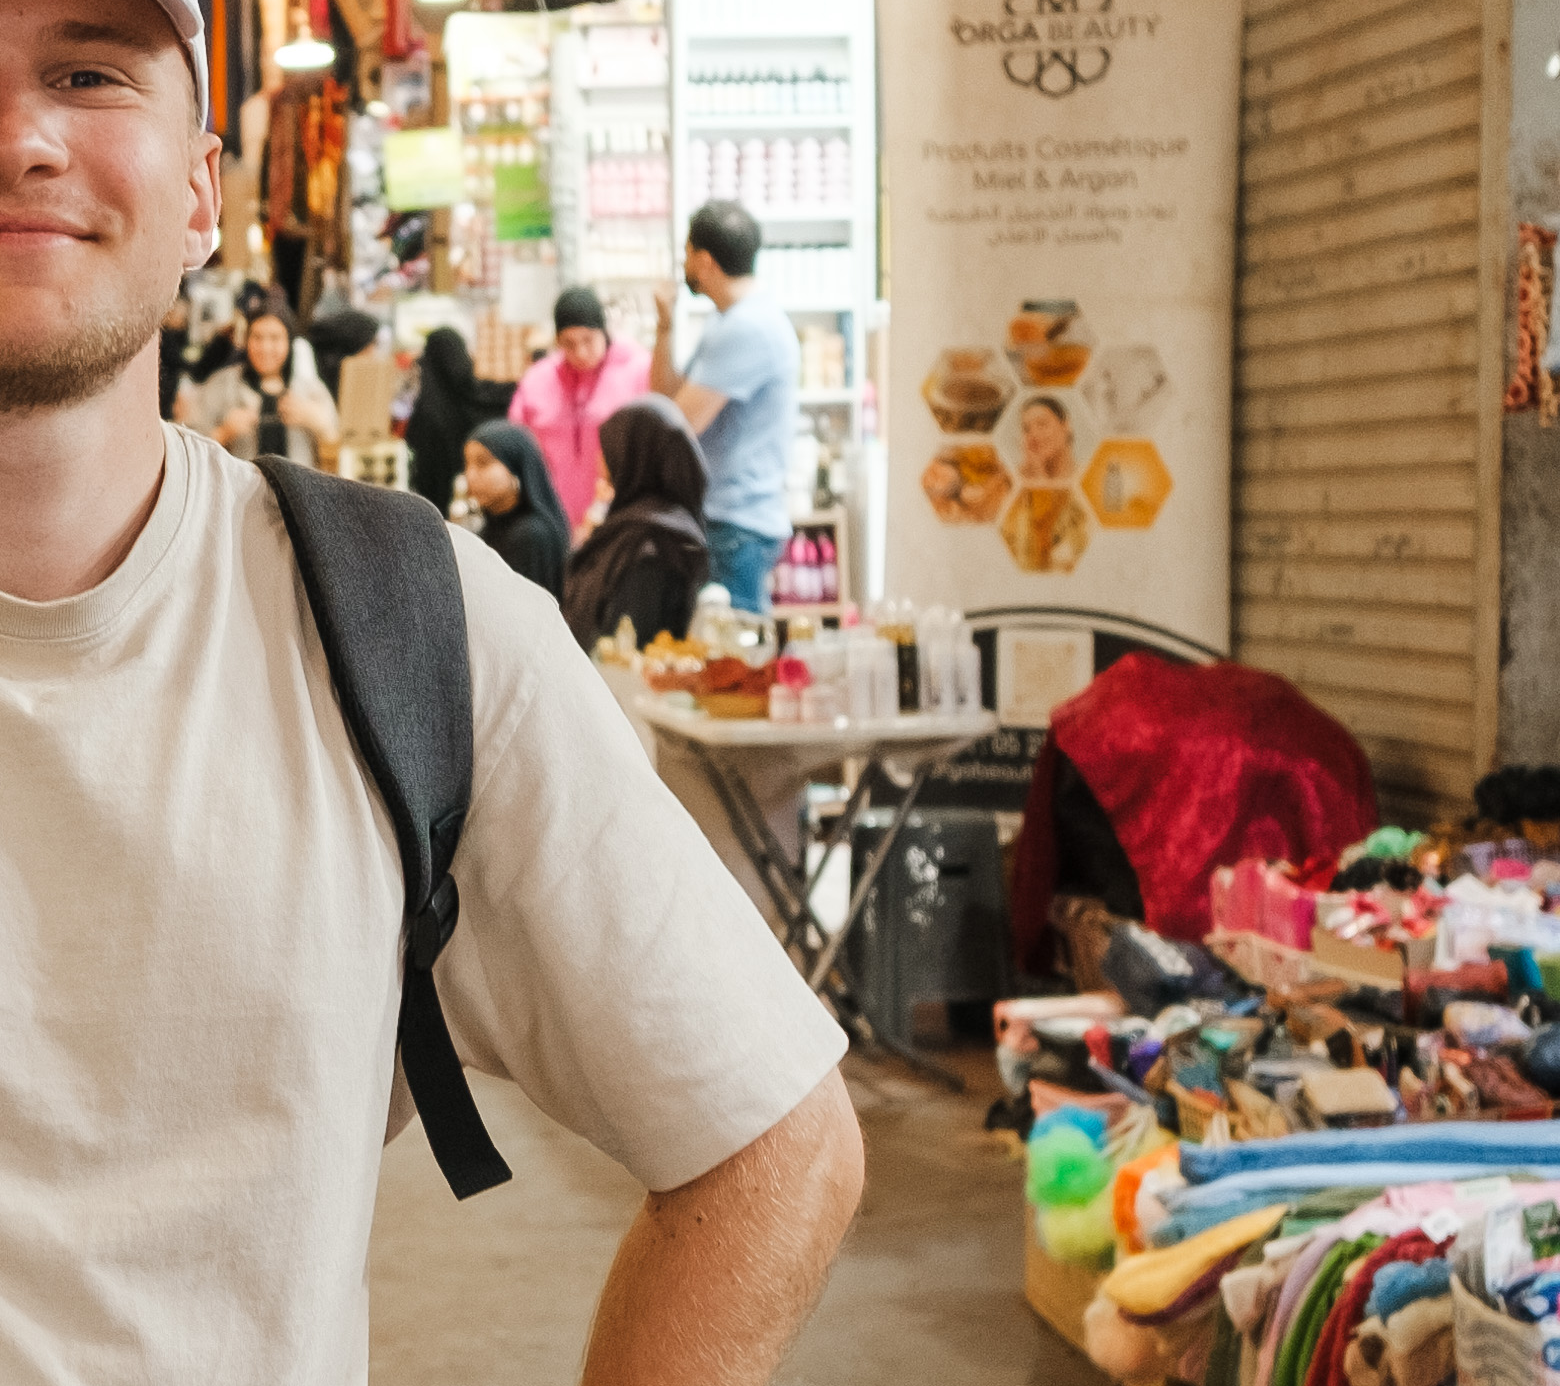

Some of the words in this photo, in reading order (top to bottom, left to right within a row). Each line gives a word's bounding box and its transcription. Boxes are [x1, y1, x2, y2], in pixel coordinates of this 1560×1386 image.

[1047, 13, 1162, 42] BEAUTY
[923, 139, 1028, 162] Produits
[973, 169, 1026, 191] Miel
[1058, 167, 1137, 195] Argan
